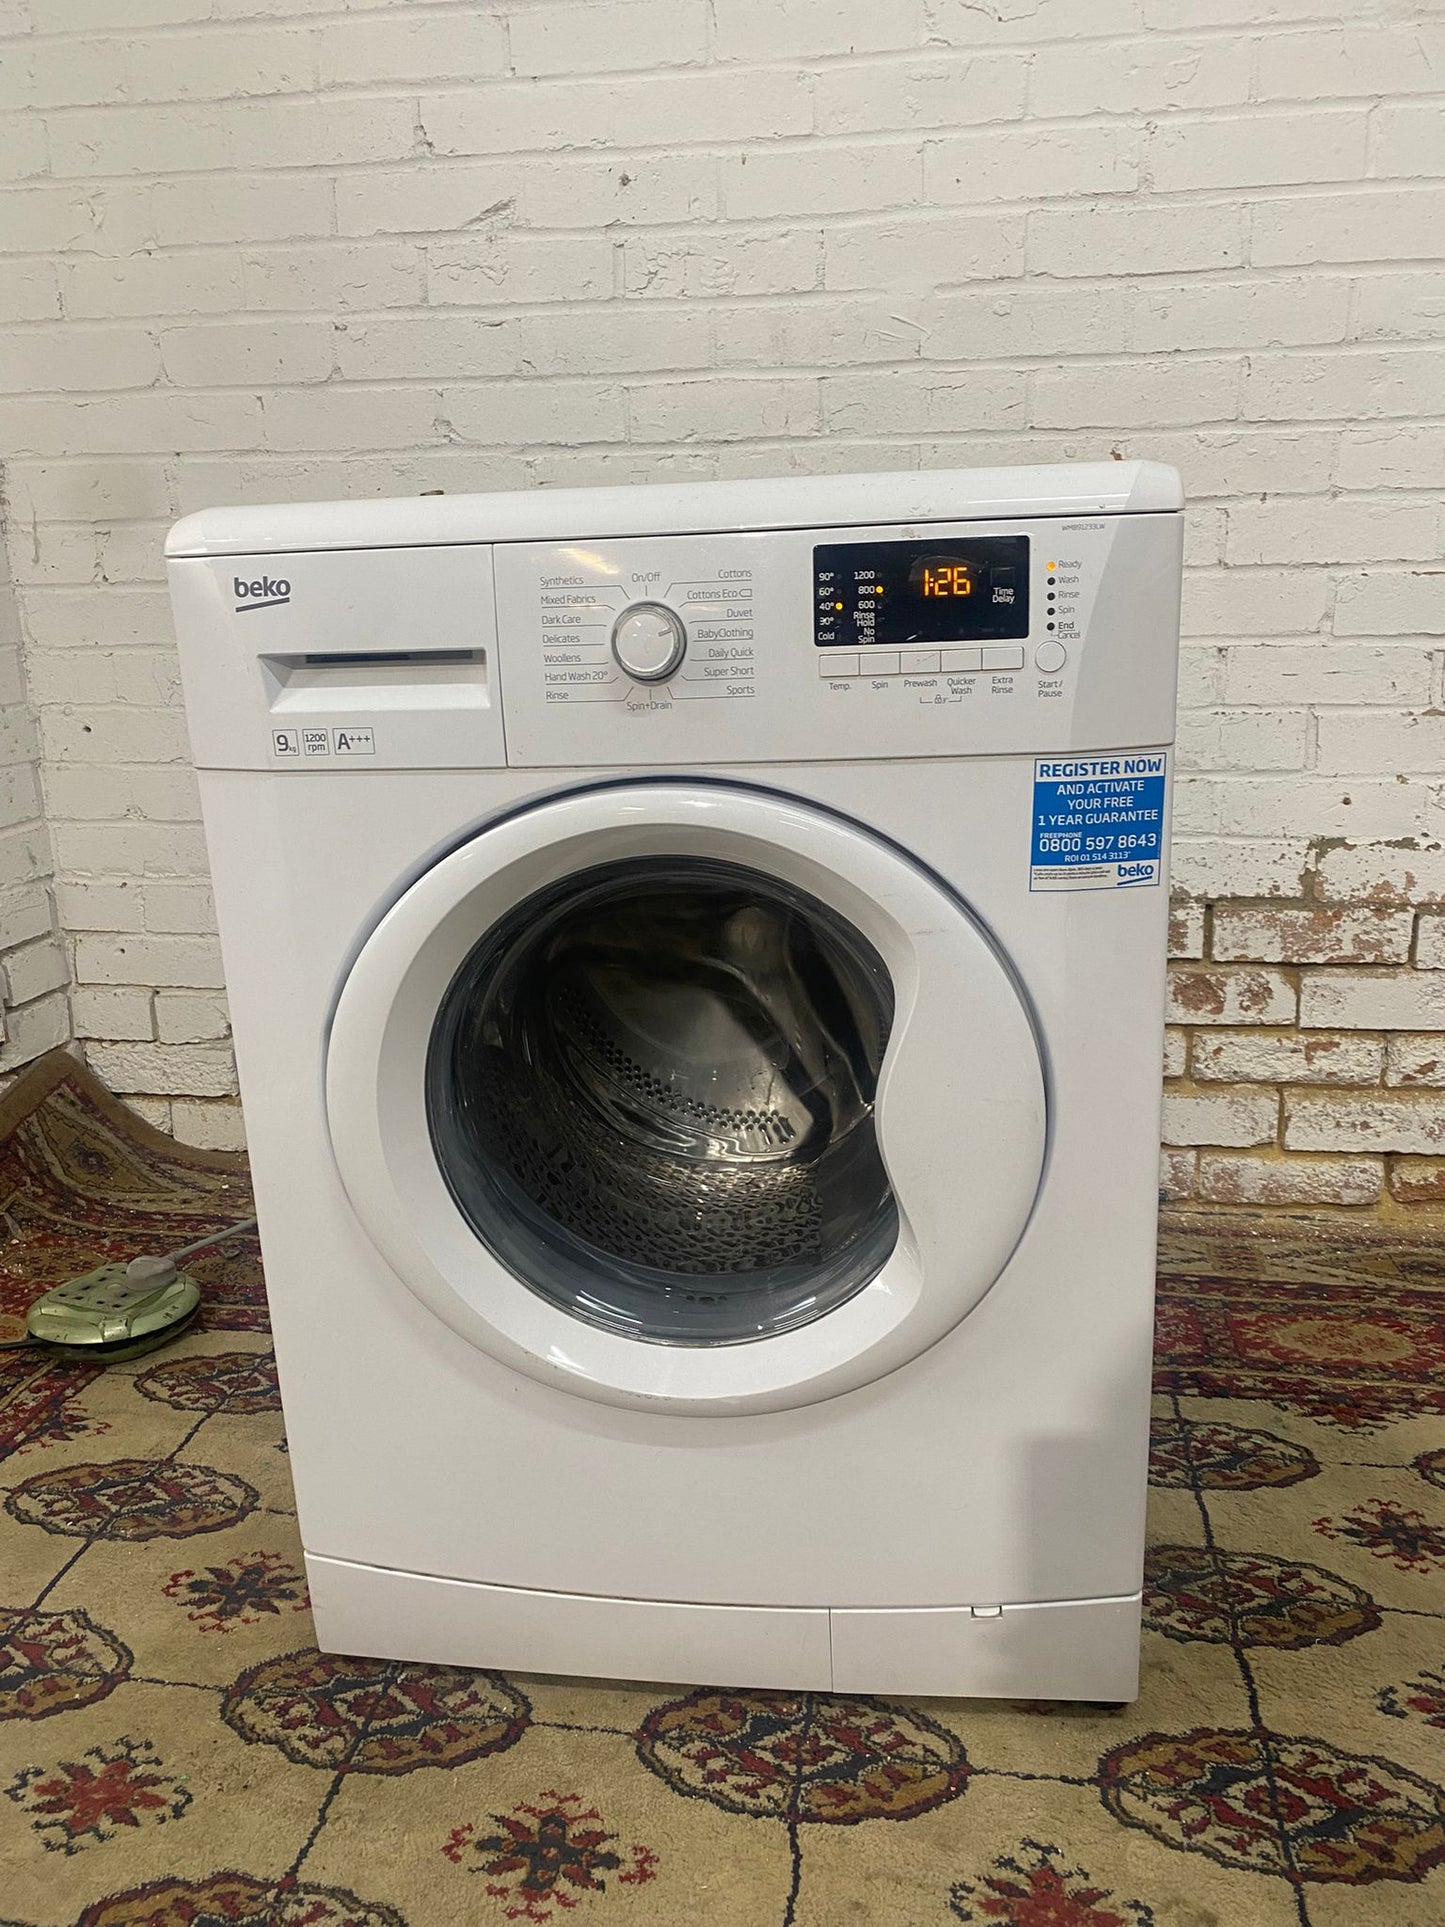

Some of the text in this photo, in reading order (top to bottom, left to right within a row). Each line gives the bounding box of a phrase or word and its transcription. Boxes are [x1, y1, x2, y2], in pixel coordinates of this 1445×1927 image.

[1058, 560, 1082, 570] Ready
[631, 572, 661, 582] On/Off
[718, 569, 752, 579] Cottons
[853, 571, 875, 580] 1200
[540, 576, 584, 587] Synthetics
[923, 566, 971, 597] 1:26
[1058, 576, 1079, 584] Wash
[234, 576, 291, 598] beko
[857, 586, 875, 594] 800
[993, 587, 1014, 595] Time
[540, 594, 596, 604] Mixed Fabrics
[686, 588, 737, 600] Cottons Eco
[1058, 591, 1080, 599] Rinse
[992, 595, 1015, 604] Delay
[858, 601, 875, 609] 600
[726, 608, 753, 618] Duvet
[853, 611, 875, 620] Rinse
[1058, 606, 1075, 615] Spin
[541, 615, 581, 625] Dark Care
[856, 619, 875, 627] Hold
[1058, 621, 1075, 630] End
[817, 632, 835, 641] Cold
[863, 628, 875, 636] No
[1057, 630, 1081, 640] Cancel
[542, 634, 581, 644] Delicates
[857, 635, 876, 645] Spin
[708, 647, 754, 659] Daily Quick
[543, 654, 582, 663] Woollens
[544, 673, 567, 682] Hand
[568, 672, 591, 682] Wash
[703, 666, 755, 678] Super Short
[871, 680, 889, 690] Spin
[904, 679, 938, 688] Prewash
[947, 678, 977, 687] Quicker
[992, 676, 1014, 685] Extra
[726, 685, 756, 696] Sports
[829, 682, 852, 692] Temp.
[951, 686, 973, 695] Wash
[992, 685, 1014, 694] Rinse
[545, 690, 569, 700] Rinse
[1038, 689, 1063, 698] Pause
[626, 701, 673, 712] Spin+Drain
[276, 734, 289, 752] 9
[304, 733, 327, 743] 1200
[337, 733, 371, 750] A+++
[307, 743, 326, 753] rpm
[1039, 758, 1162, 777] REGISTER NOW
[1056, 780, 1145, 796] AND ACTIVATE
[1067, 796, 1134, 810] YOUR FREE
[1038, 809, 1159, 826] 1 YEAR GUARANTEE
[1040, 838, 1081, 852] 0800
[1085, 836, 1115, 851] 597
[1117, 833, 1157, 849] 8643
[1064, 855, 1079, 863] ROI
[1092, 852, 1107, 861] 514
[1117, 863, 1154, 877] beko
